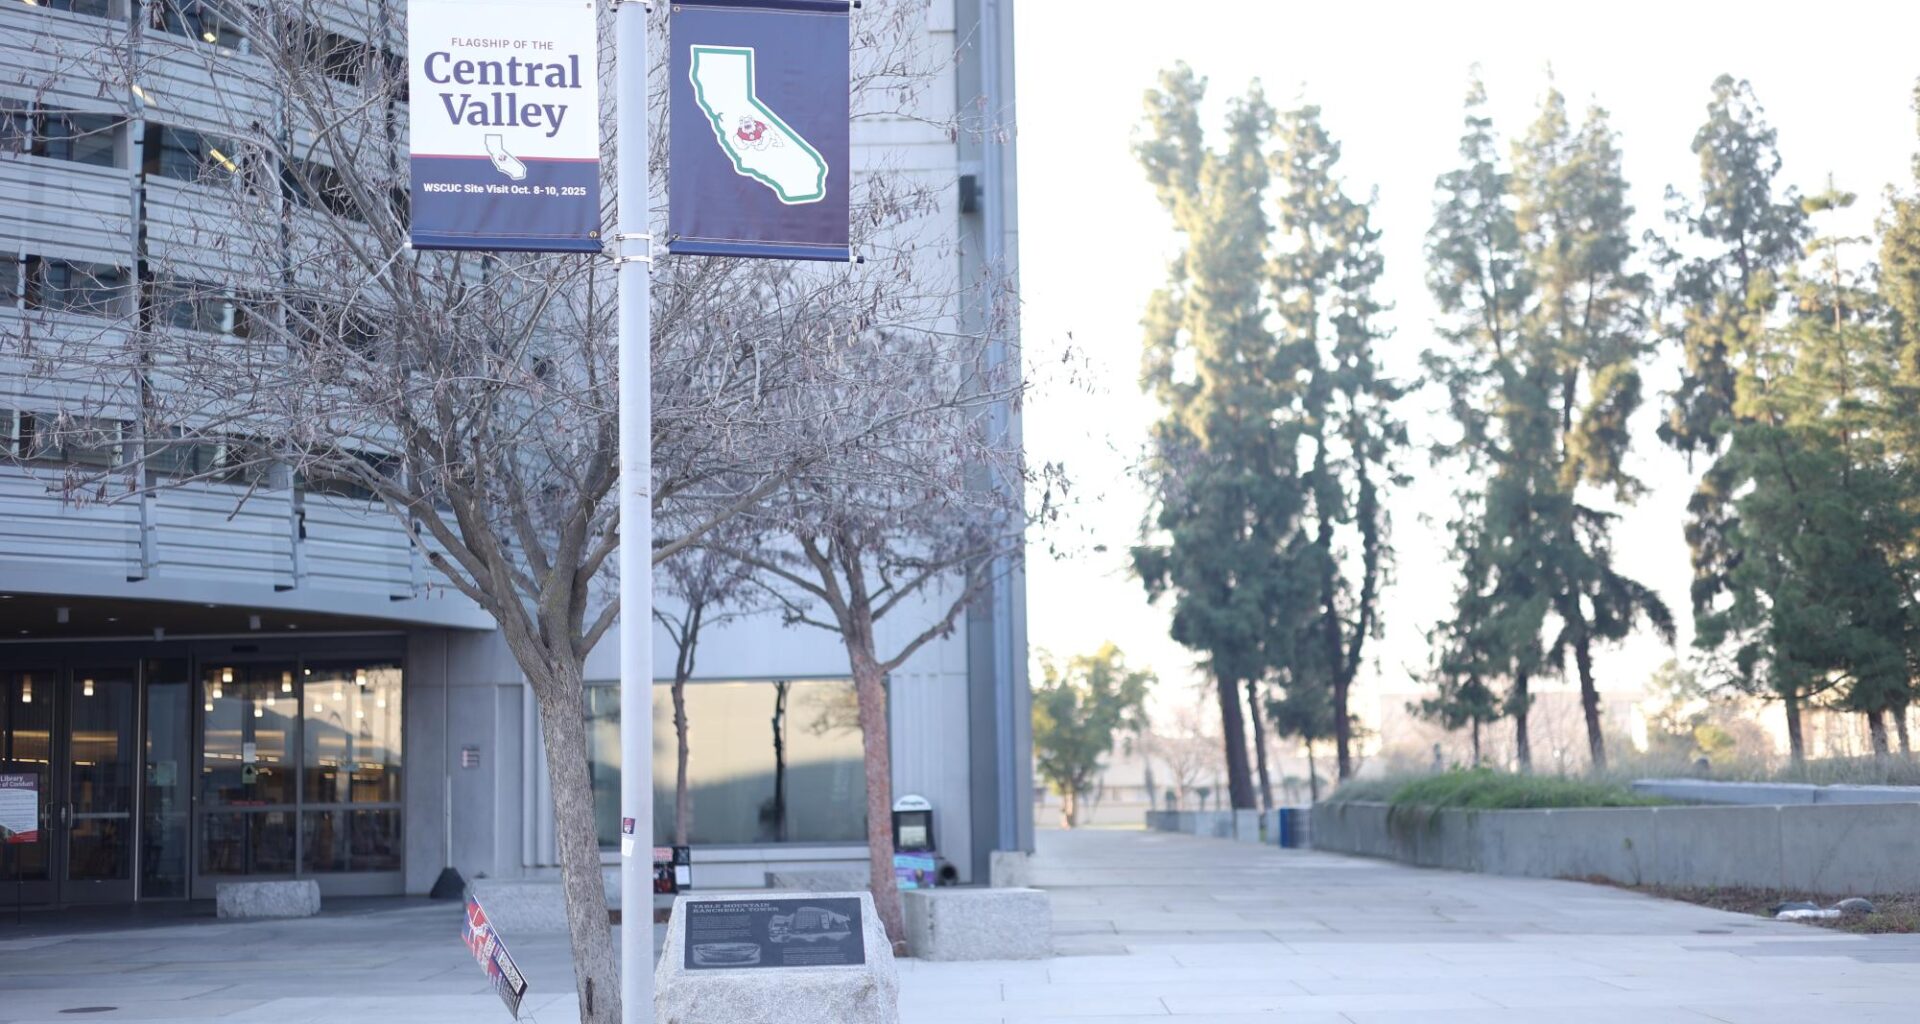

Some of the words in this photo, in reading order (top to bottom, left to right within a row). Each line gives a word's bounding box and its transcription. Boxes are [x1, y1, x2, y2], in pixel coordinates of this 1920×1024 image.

[451, 37, 510, 48] FLAGSHIP
[513, 40, 528, 49] OF
[532, 41, 553, 50] THE
[424, 51, 582, 89] Central
[439, 92, 568, 138] Valley
[423, 183, 462, 193] WSCUC
[464, 183, 484, 193] Site
[486, 184, 509, 194] Visit
[511, 185, 531, 195] Oct.
[533, 186, 559, 197] 8-10,
[561, 186, 586, 196] 2025
